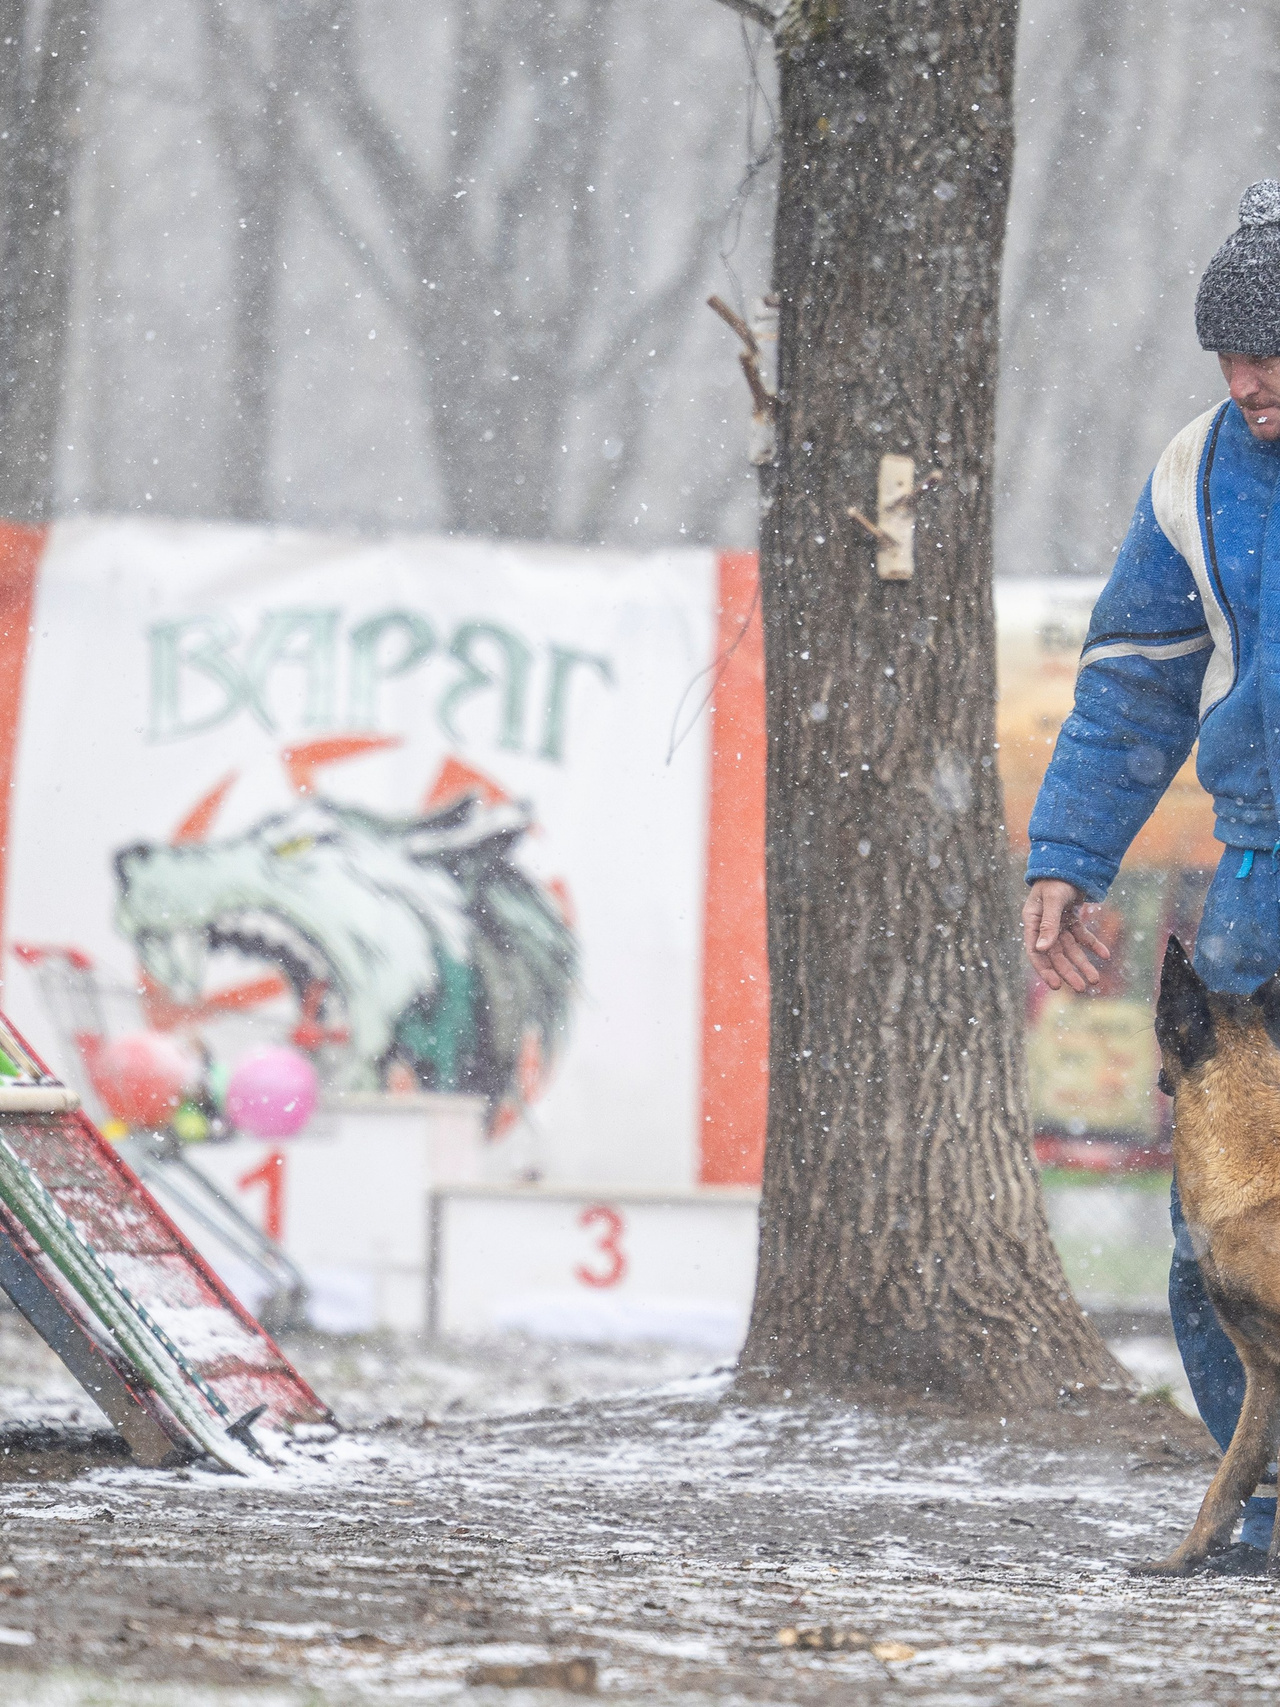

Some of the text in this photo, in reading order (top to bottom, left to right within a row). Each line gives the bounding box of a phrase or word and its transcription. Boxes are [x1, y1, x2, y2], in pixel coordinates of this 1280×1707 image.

[146, 606, 614, 762] ВАРЯГ
[238, 1149, 284, 1243] 1
[574, 1205, 627, 1289] 3
